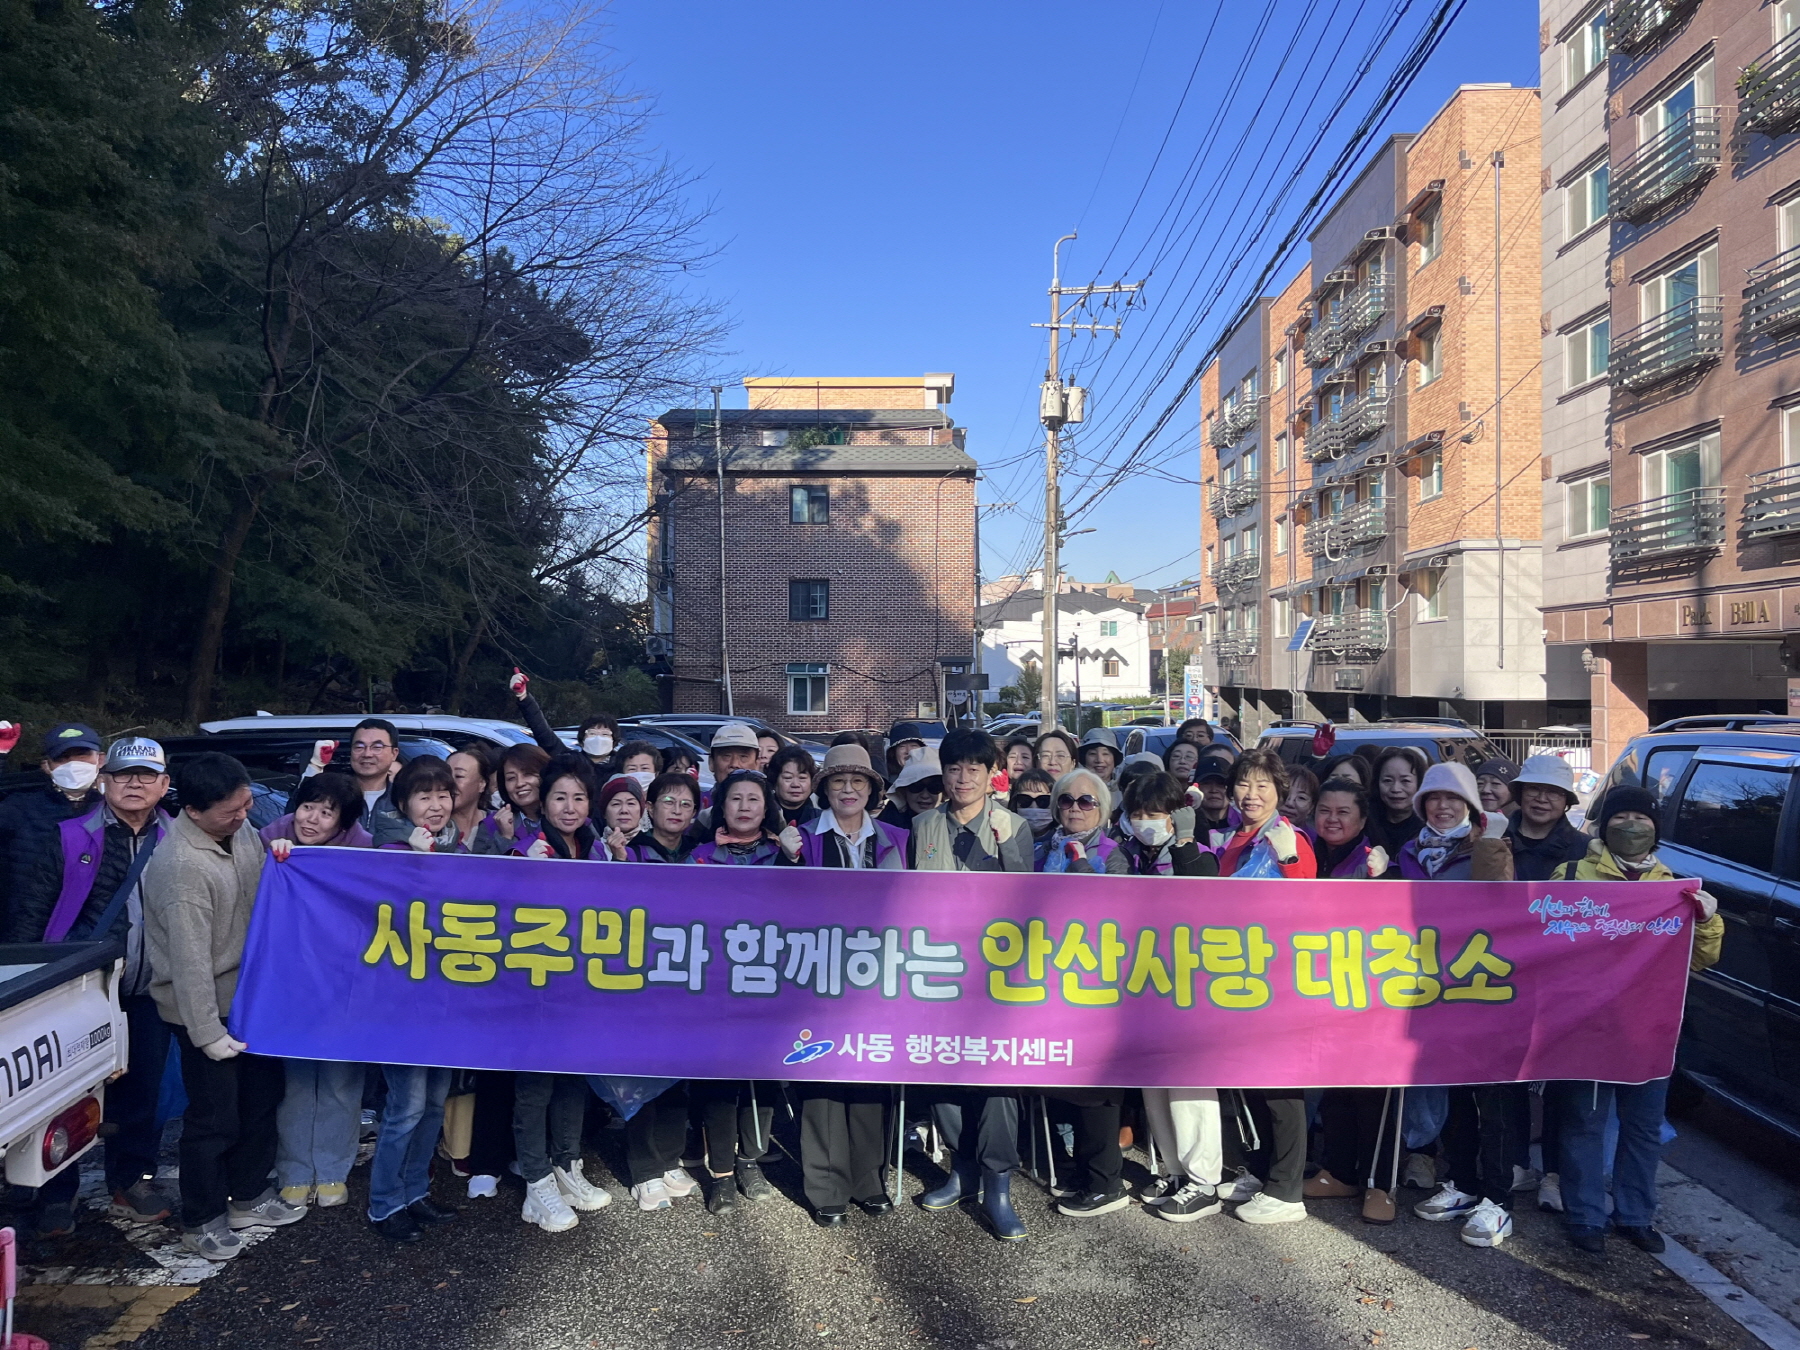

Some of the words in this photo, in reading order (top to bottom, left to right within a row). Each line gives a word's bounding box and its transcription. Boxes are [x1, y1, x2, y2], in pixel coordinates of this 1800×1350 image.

[1682, 603, 1712, 626] Park
[1528, 894, 1578, 924] 시민과
[1543, 919, 1592, 942] 자유로운
[1594, 918, 1646, 941] 혁신도시
[1646, 916, 1684, 936] 안산
[363, 900, 709, 991] 사동주민과
[724, 922, 965, 999] 함께하는
[981, 919, 1274, 1009] 안산사랑
[1292, 926, 1513, 1009] 대청소
[837, 1032, 895, 1062] 사동
[905, 1034, 1074, 1067] 행정복지센터
